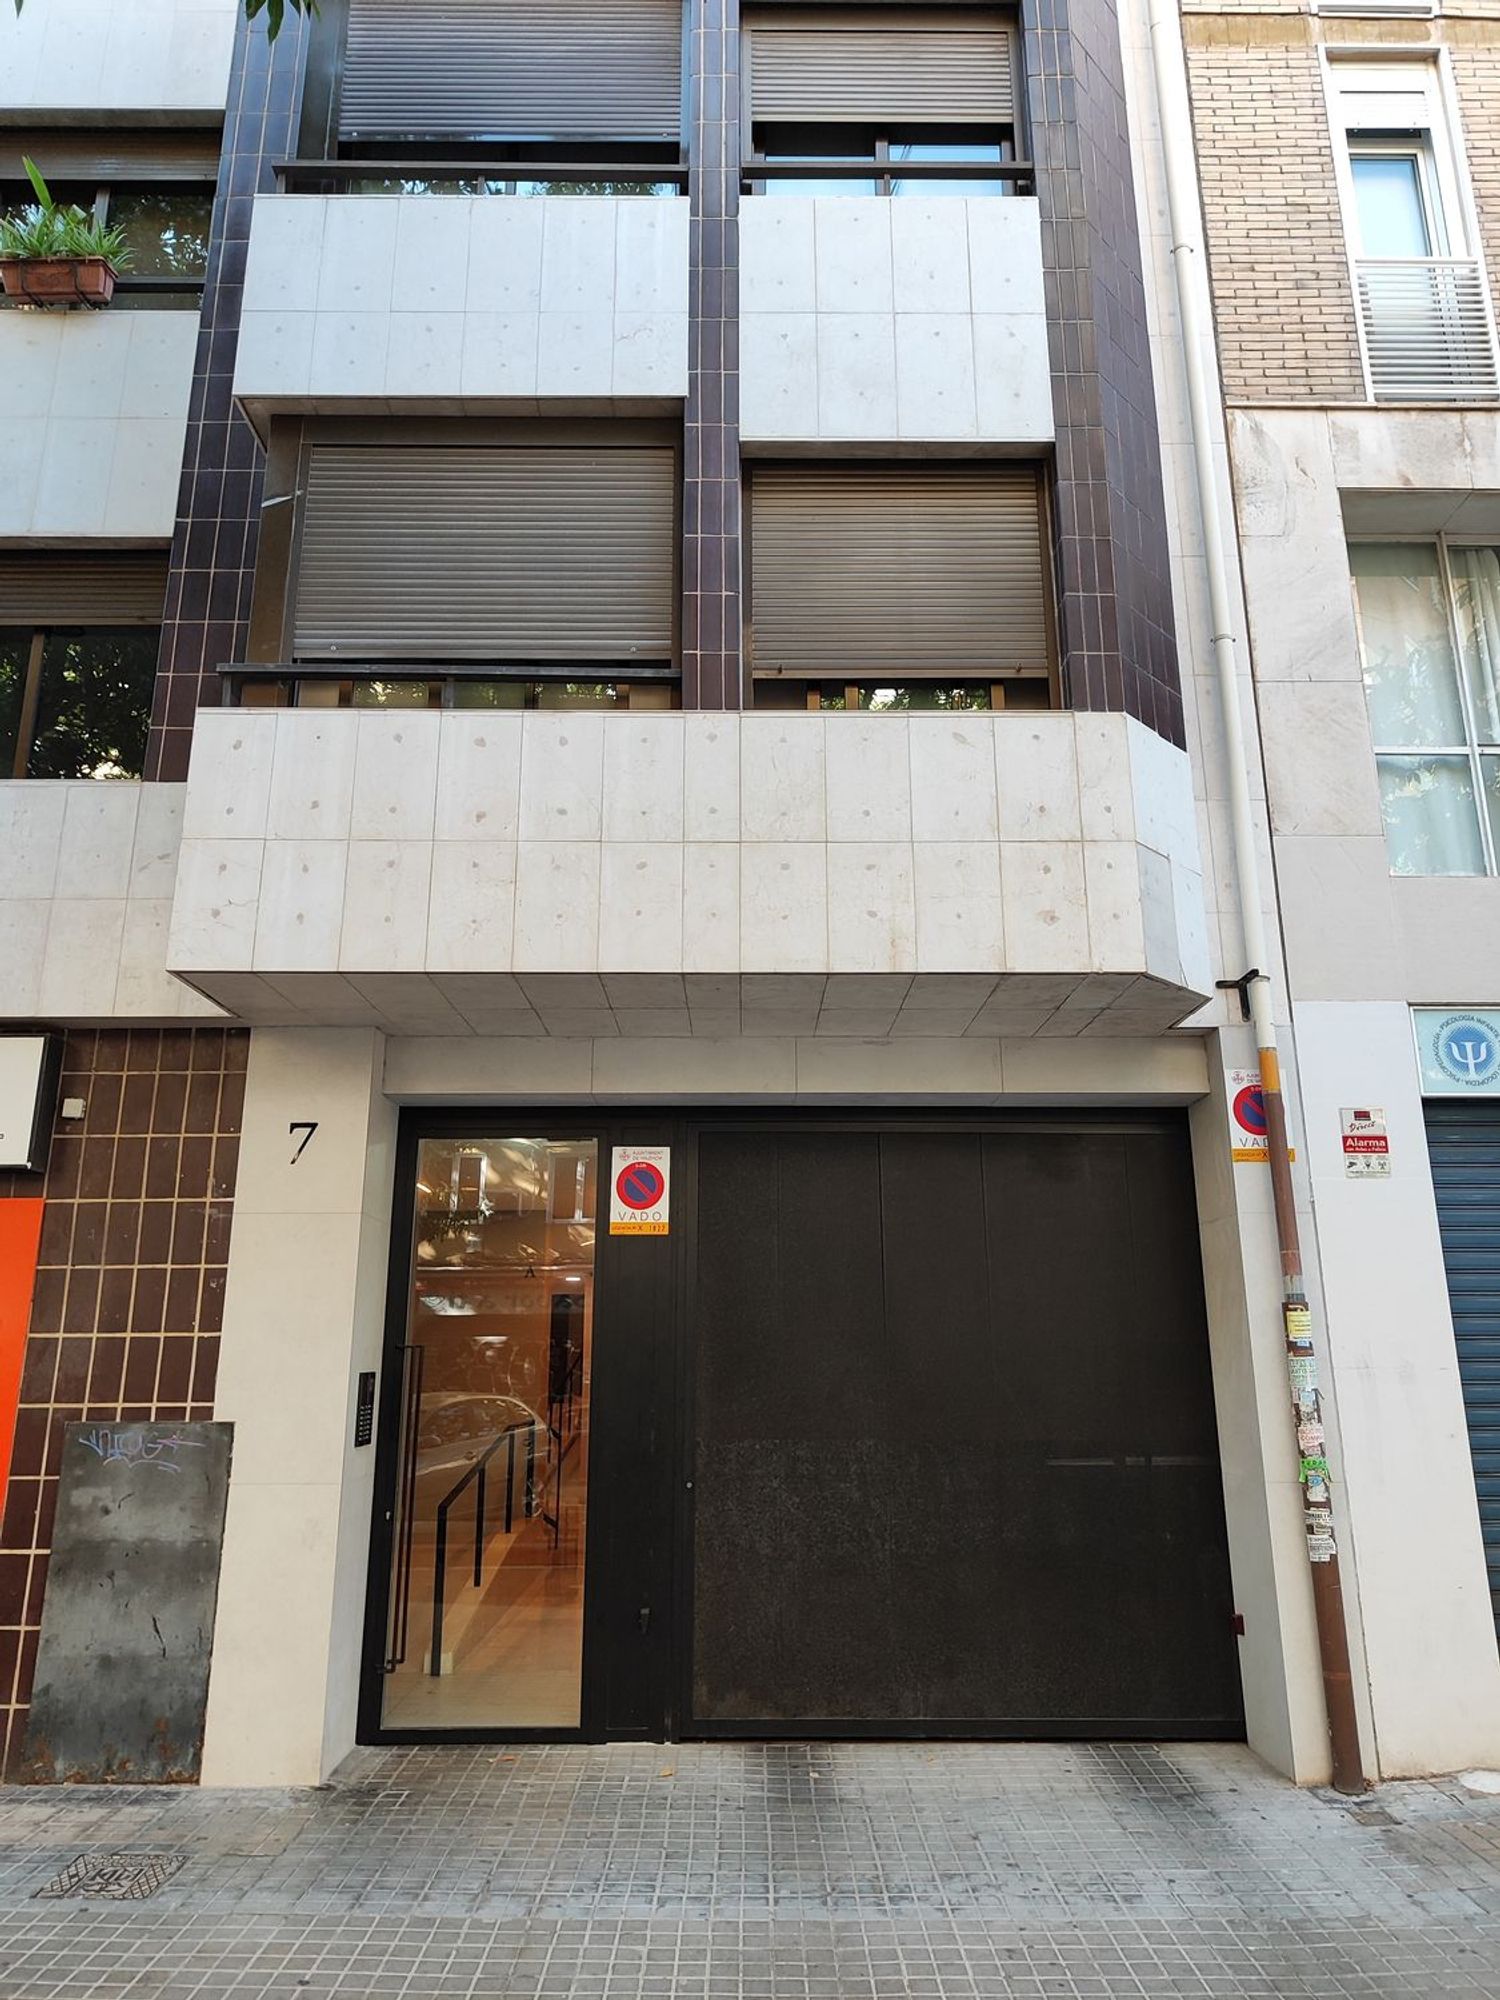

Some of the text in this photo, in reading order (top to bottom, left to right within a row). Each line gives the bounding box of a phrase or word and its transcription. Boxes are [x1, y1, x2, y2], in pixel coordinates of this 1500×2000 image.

[290, 1122, 318, 1165] 7
[1240, 1137, 1269, 1148] VAD
[1346, 1137, 1386, 1147] Alarma
[618, 1211, 662, 1222] VADO
